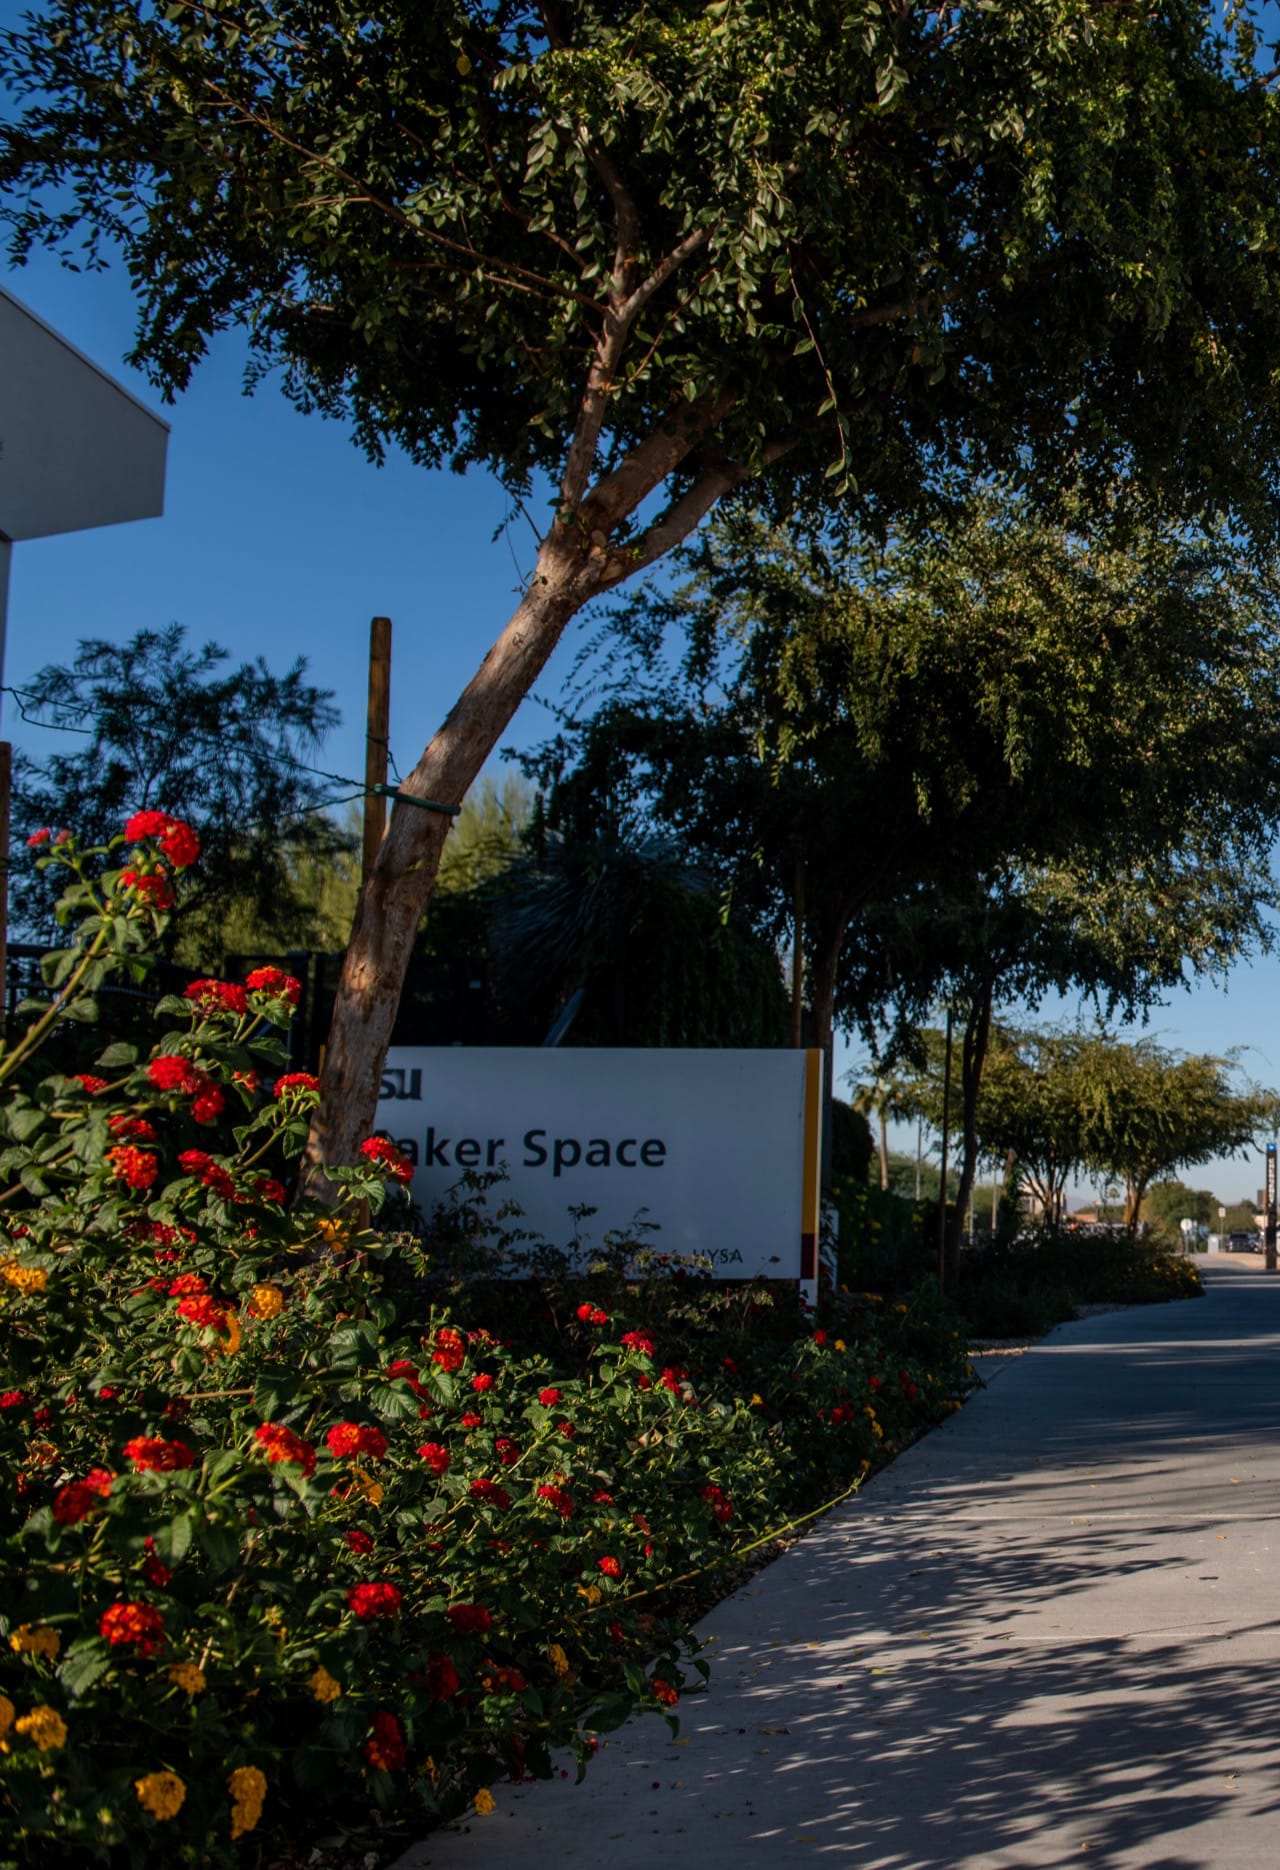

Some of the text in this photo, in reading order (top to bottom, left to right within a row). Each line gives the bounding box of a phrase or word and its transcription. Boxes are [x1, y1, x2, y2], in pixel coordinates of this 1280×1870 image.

[379, 1069, 421, 1100] SU
[374, 1127, 667, 1177] aker Space
